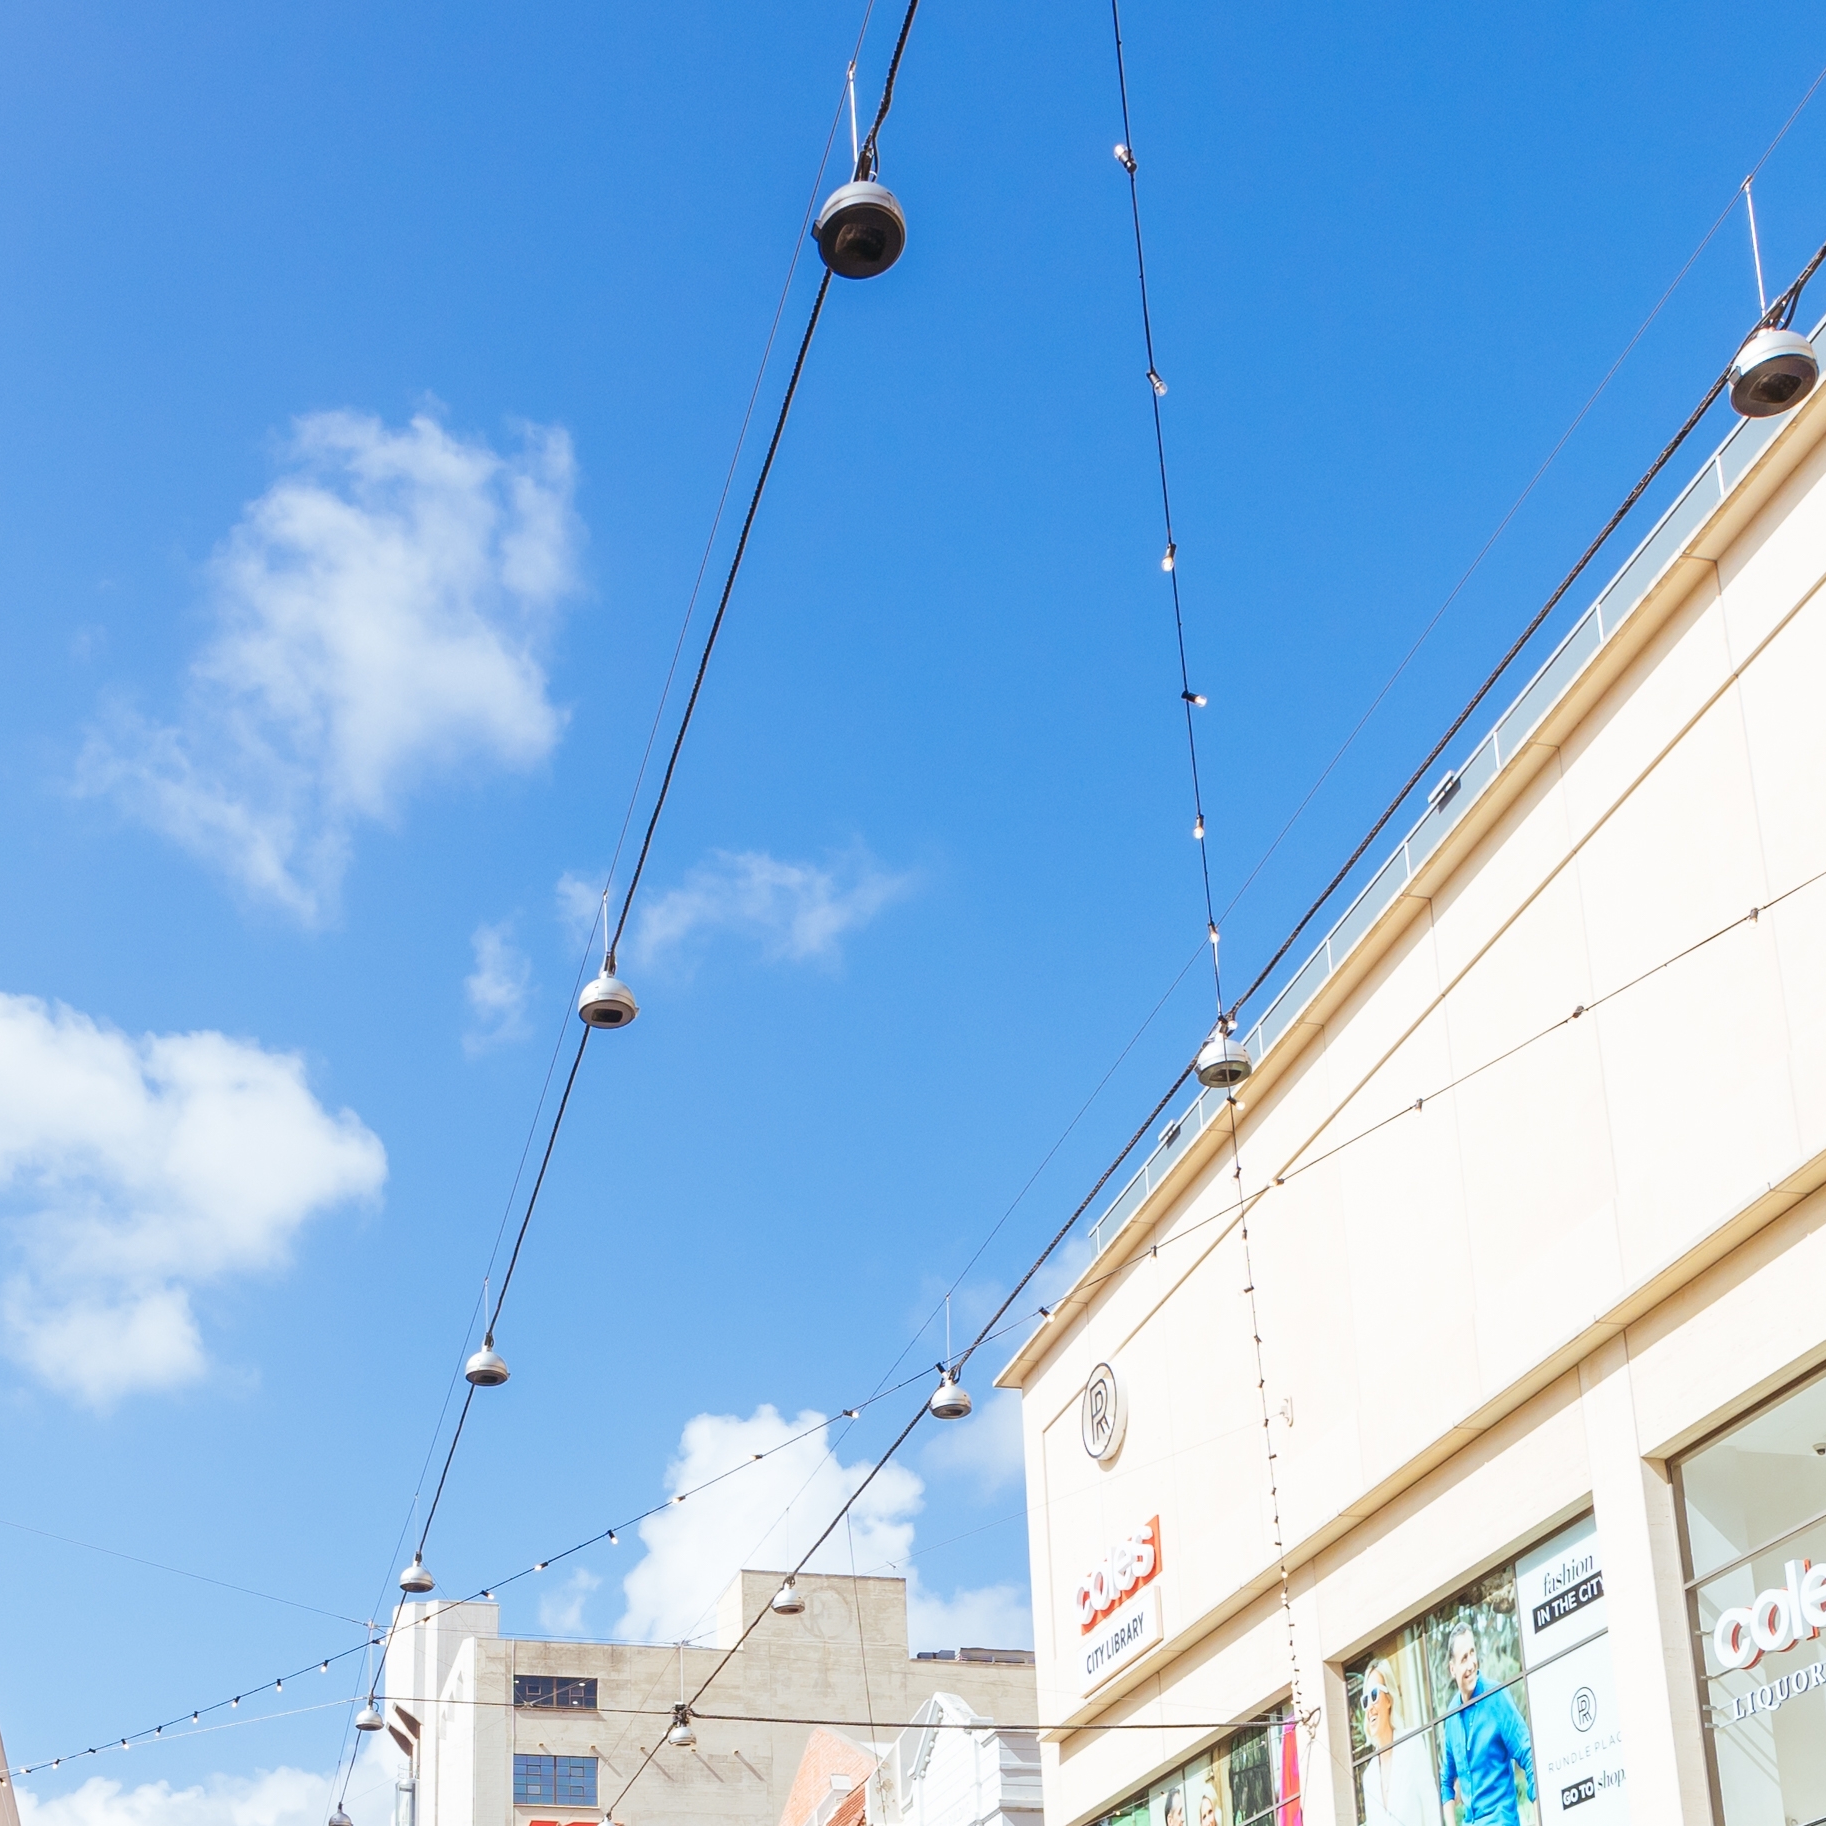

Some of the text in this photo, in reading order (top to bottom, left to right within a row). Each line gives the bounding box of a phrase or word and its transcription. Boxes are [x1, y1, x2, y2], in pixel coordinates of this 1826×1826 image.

[1075, 1525, 1155, 1625] coles
[1543, 1555, 1593, 1597] fashion
[1536, 1606, 1551, 1627] IN
[1551, 1591, 1577, 1618] THE
[1086, 1611, 1144, 1675] CITY LIBRARY
[1548, 1746, 1592, 1774] RUNDLE
[1562, 1790, 1579, 1806] GO
[1579, 1781, 1595, 1799] TO
